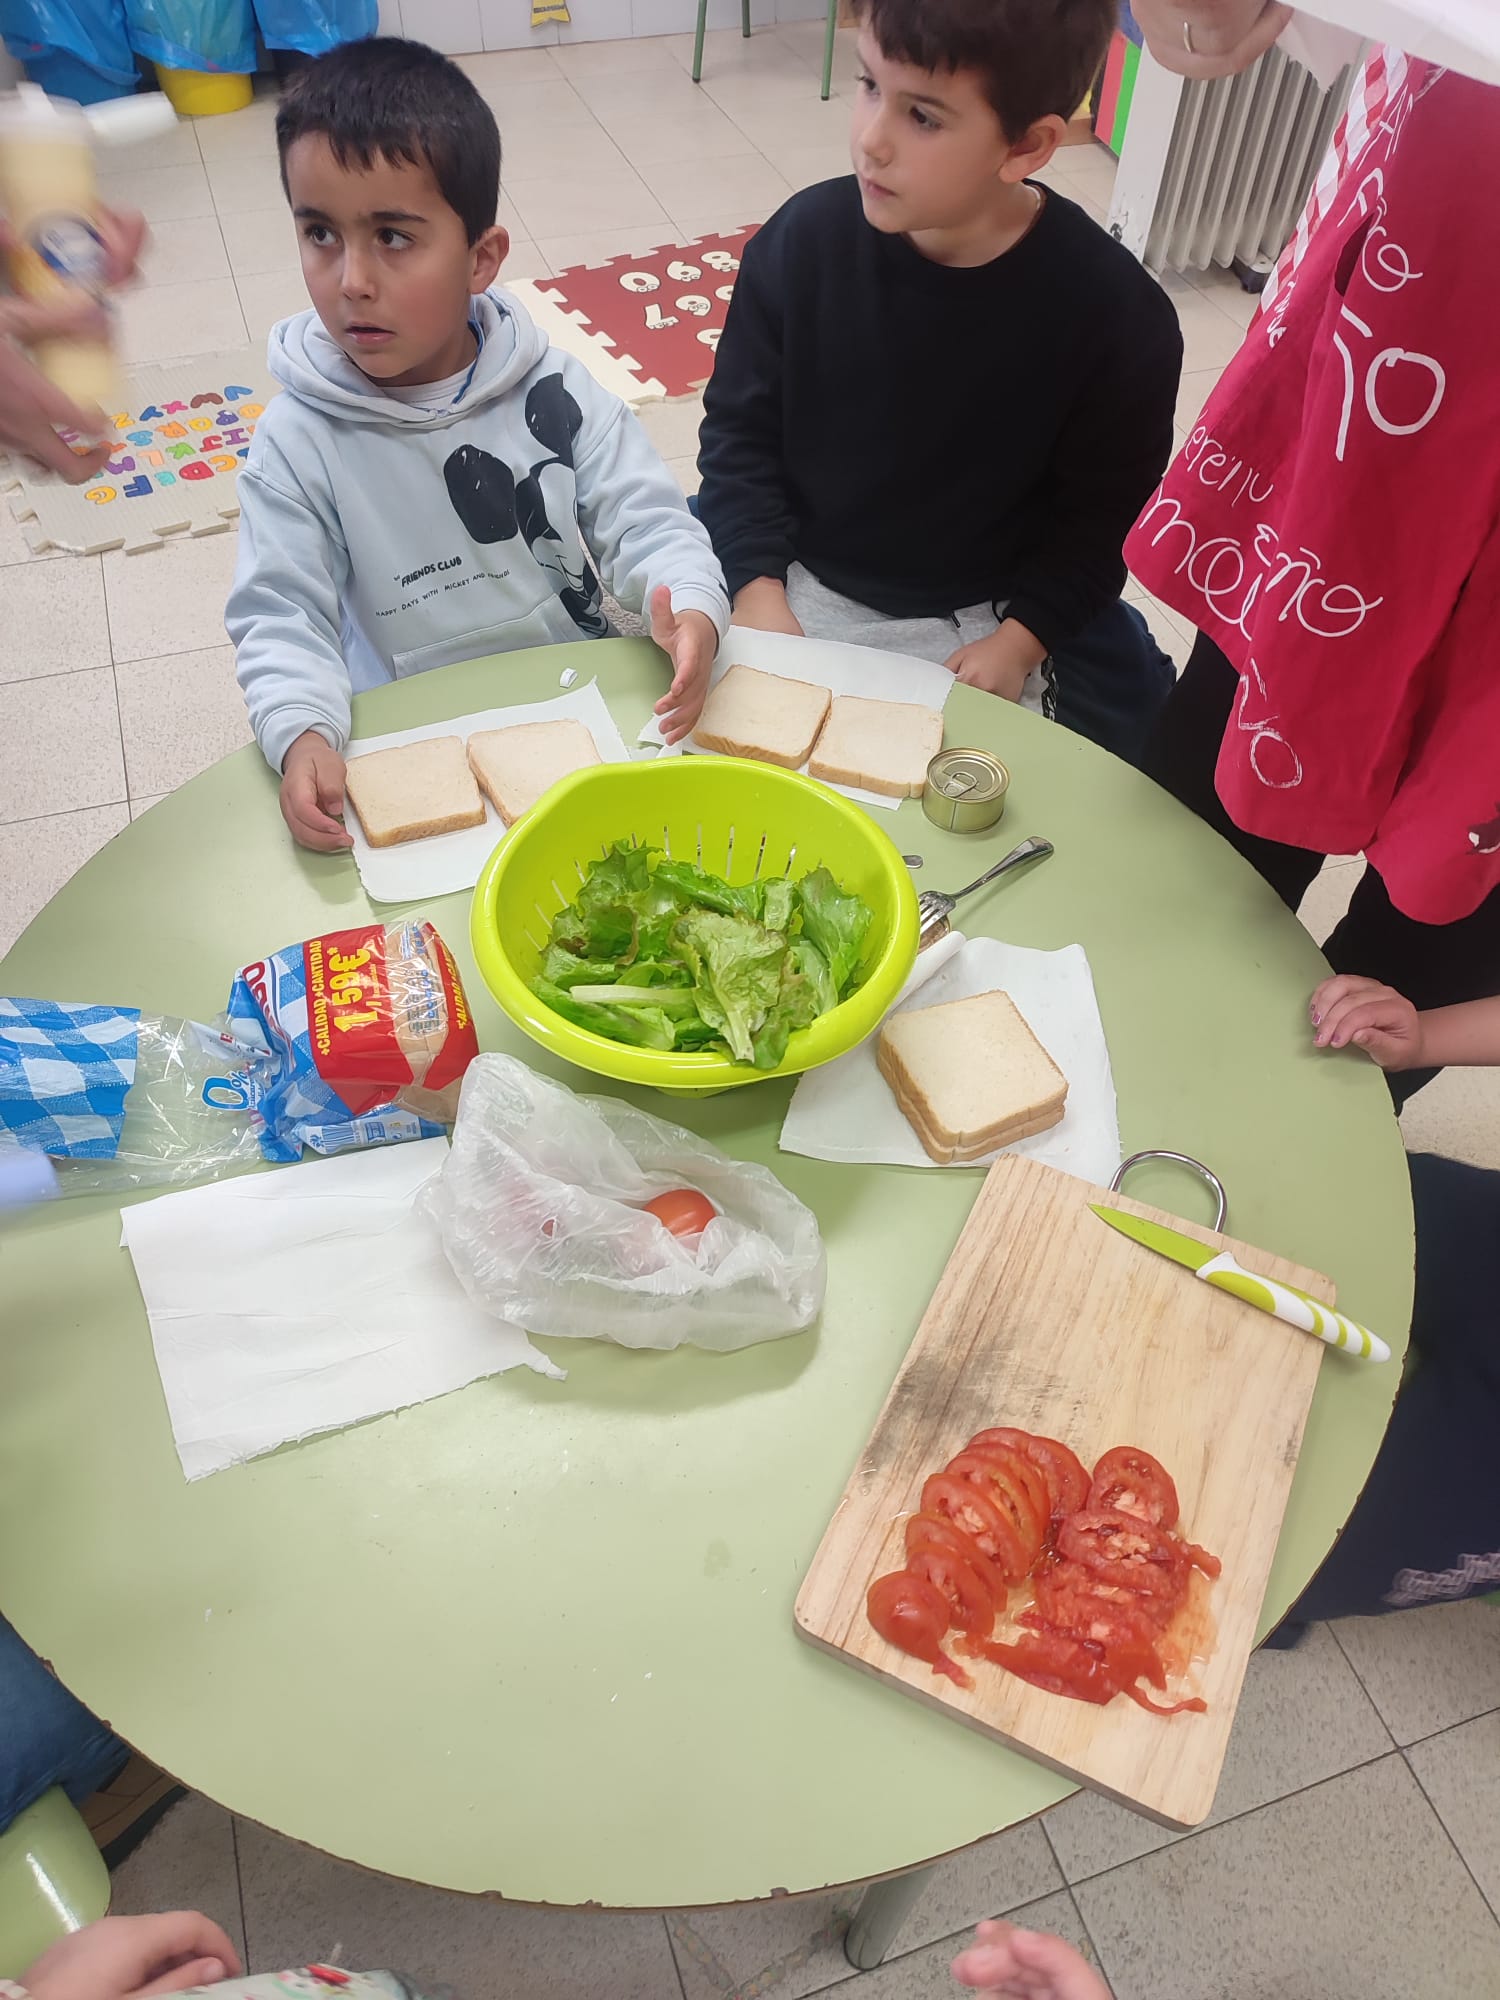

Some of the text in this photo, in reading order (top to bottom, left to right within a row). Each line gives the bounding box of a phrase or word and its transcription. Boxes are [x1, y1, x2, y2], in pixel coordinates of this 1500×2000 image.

[401, 555, 462, 588] FRIENDS CLUB
[375, 607, 397, 617] HAPPY
[401, 598, 419, 610] DAYS
[422, 588, 439, 600] WITH
[444, 578, 470, 592] MICKEY
[472, 572, 486, 581] AND
